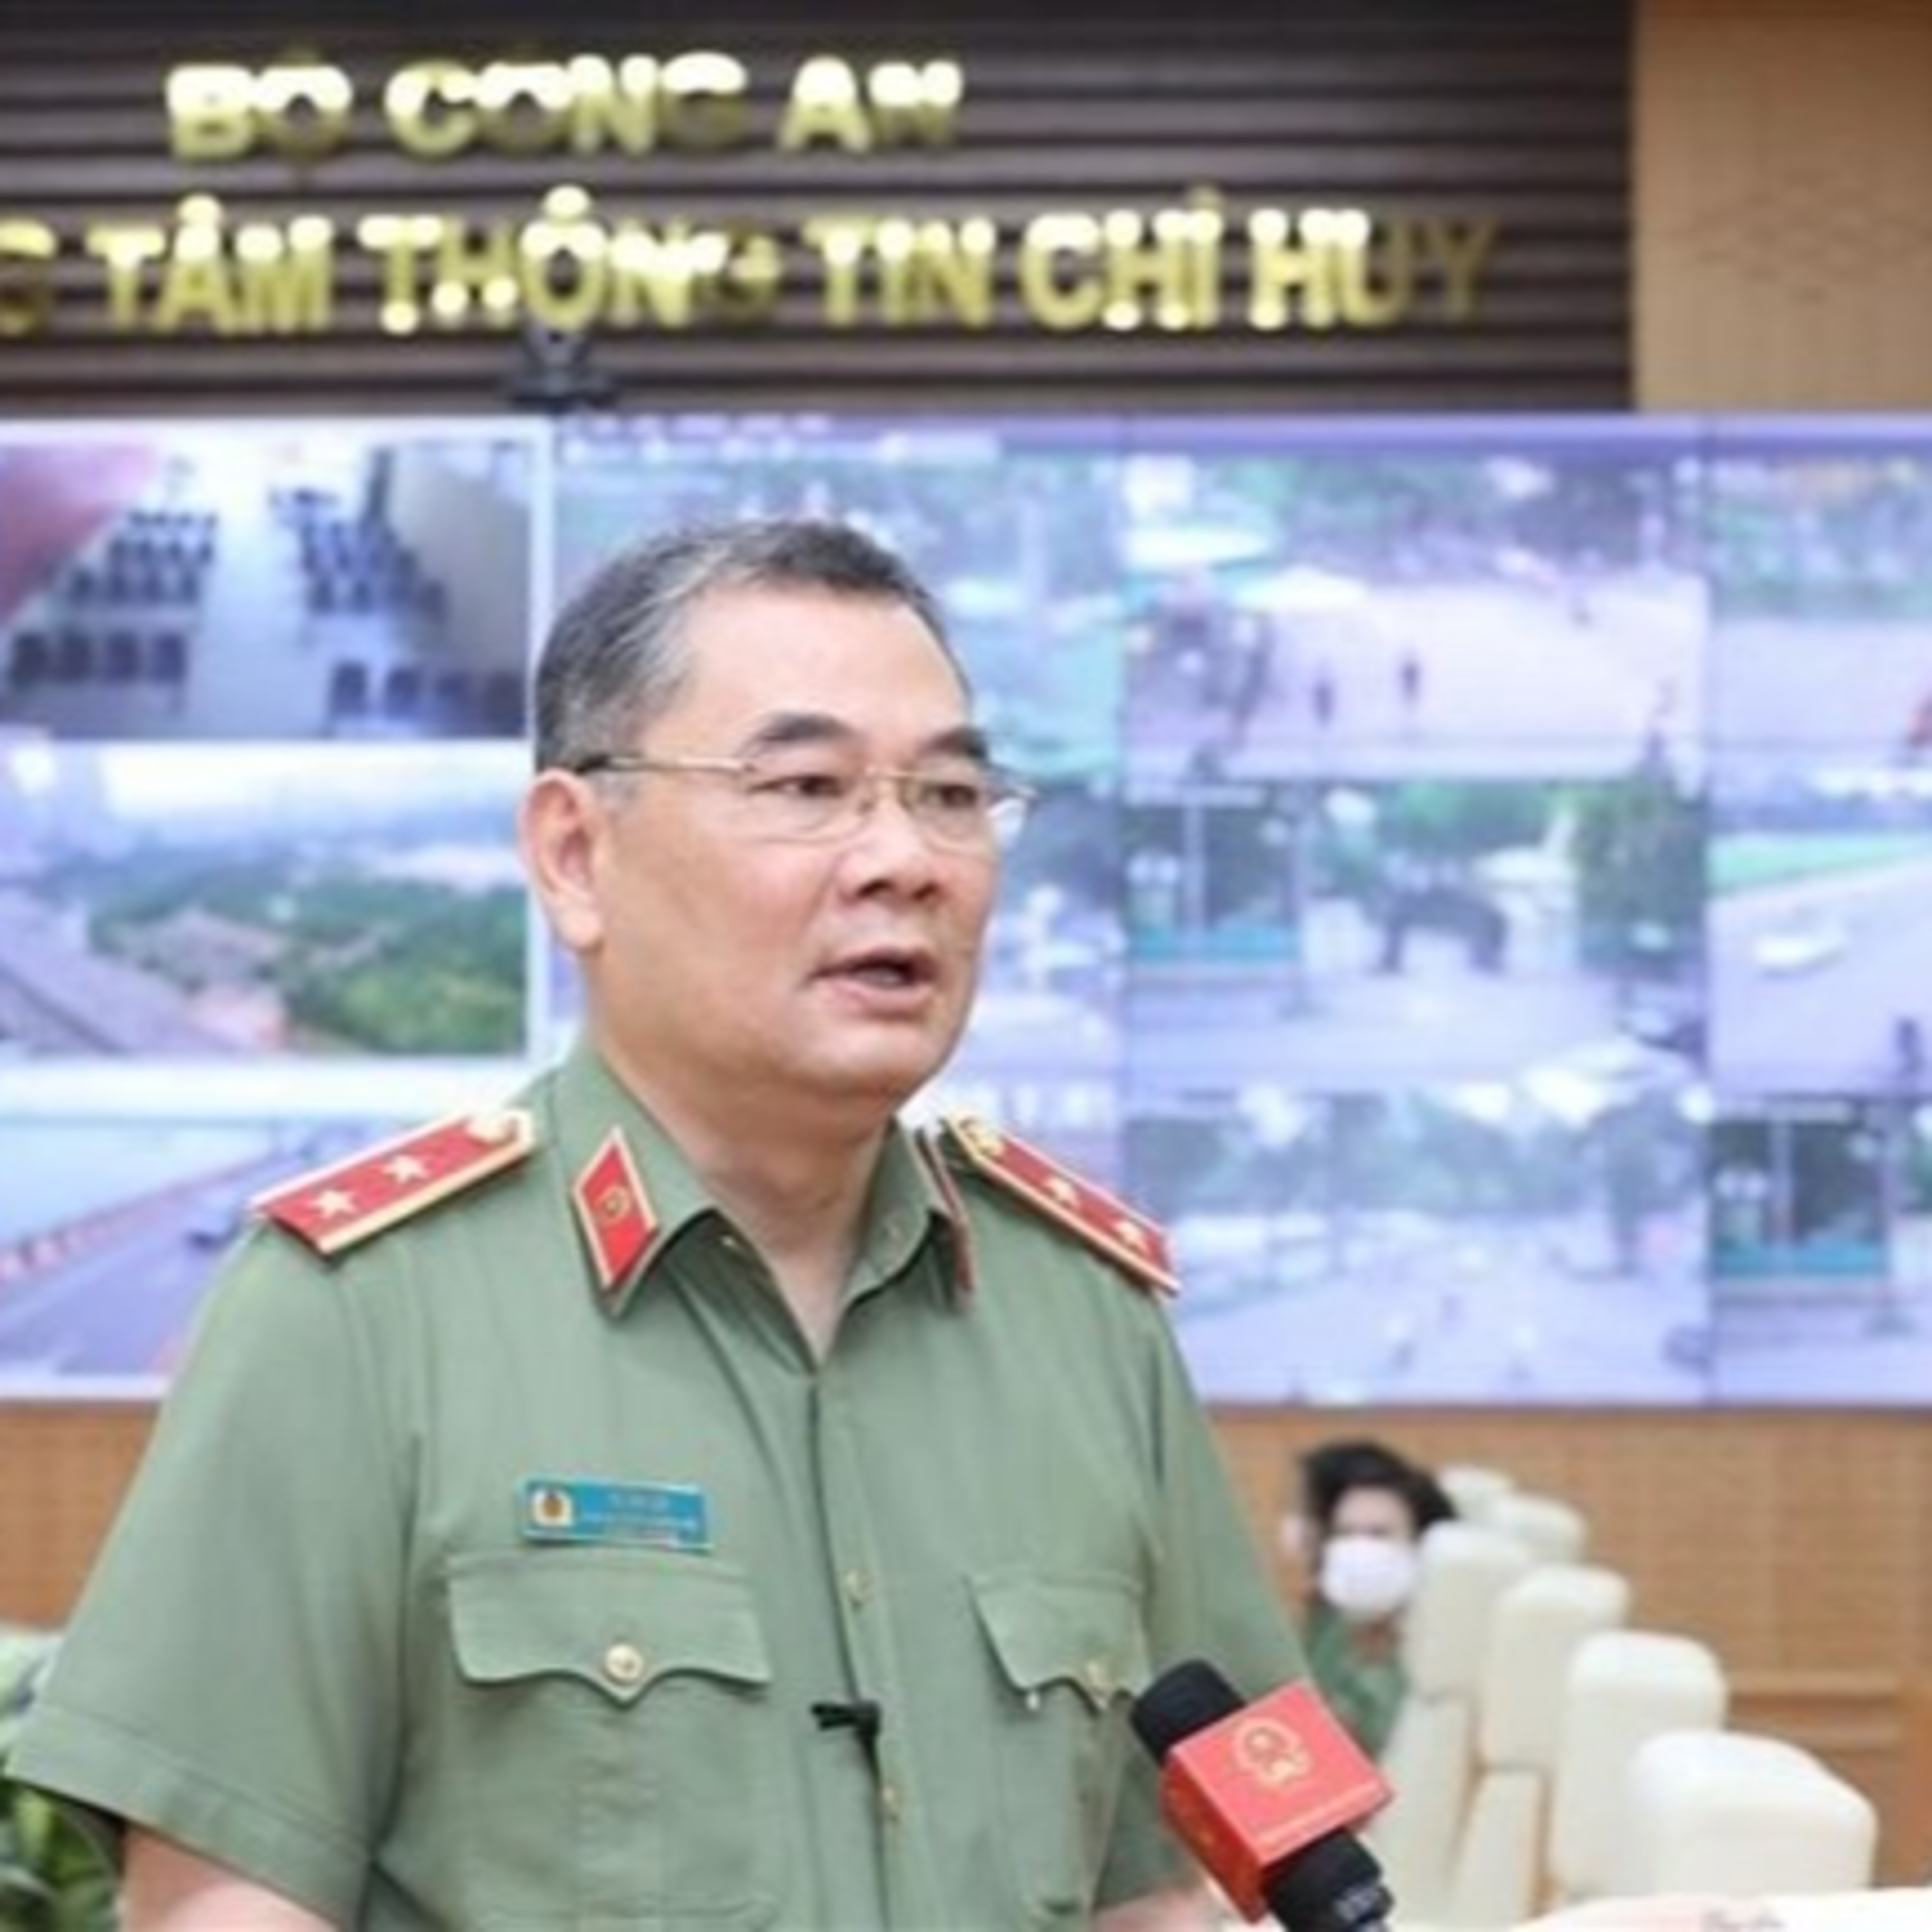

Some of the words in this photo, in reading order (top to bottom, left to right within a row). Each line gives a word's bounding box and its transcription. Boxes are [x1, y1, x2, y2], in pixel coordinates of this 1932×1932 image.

[777, 55, 963, 155] AN
[85, 193, 334, 336] TÂM
[800, 216, 996, 330] TIN
[1247, 207, 1497, 327] HUY
